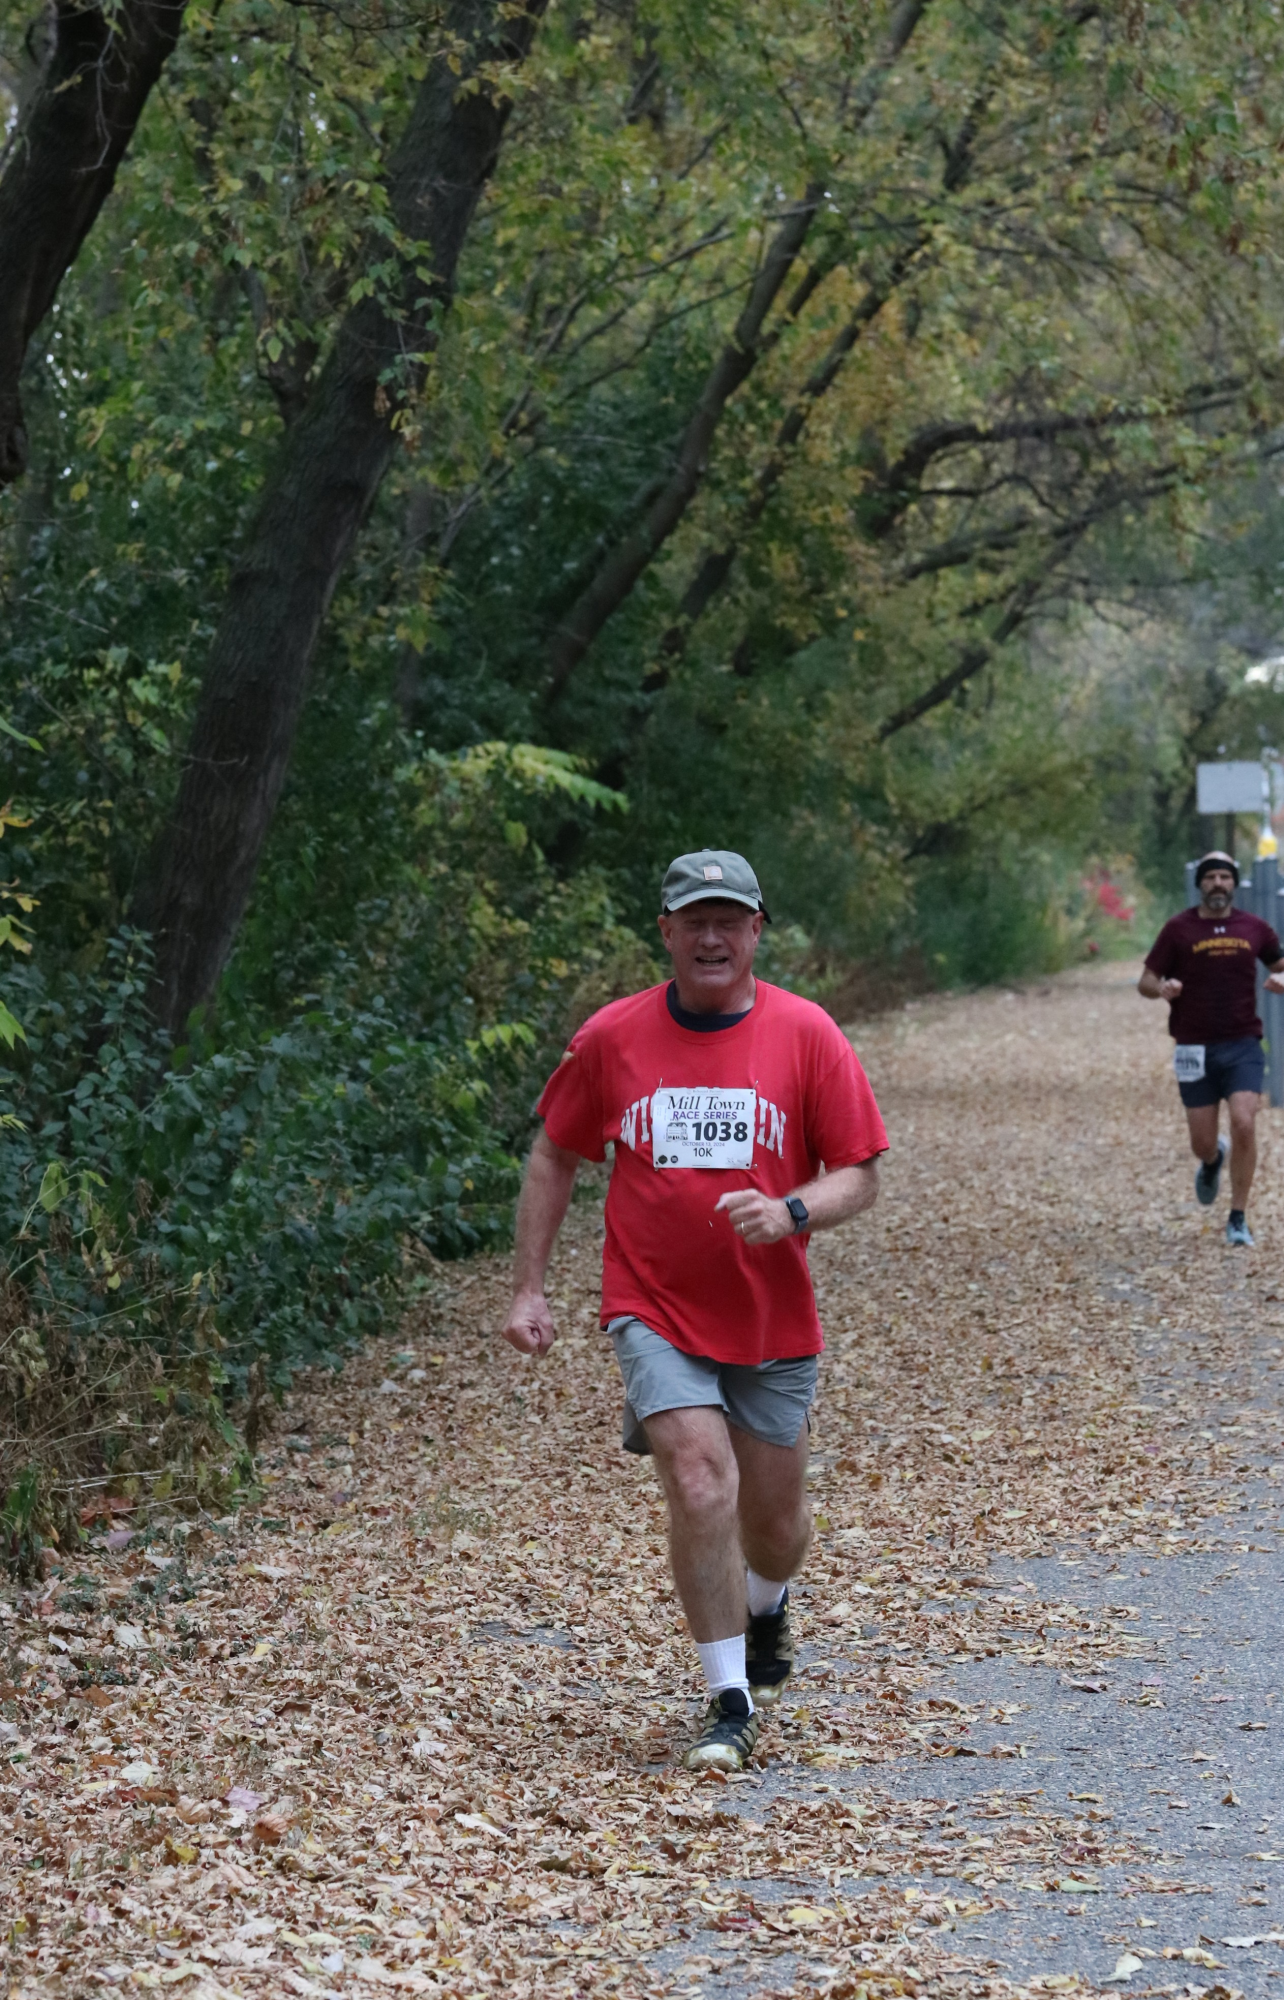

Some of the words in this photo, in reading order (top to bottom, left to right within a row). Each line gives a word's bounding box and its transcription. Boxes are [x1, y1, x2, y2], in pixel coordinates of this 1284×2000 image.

[667, 1095, 701, 1110] Mill
[706, 1096, 746, 1111] Town
[672, 1110, 700, 1120] RACE
[703, 1111, 738, 1120] SERIES
[691, 1121, 748, 1142] 1038
[693, 1147, 713, 1157] 10K
